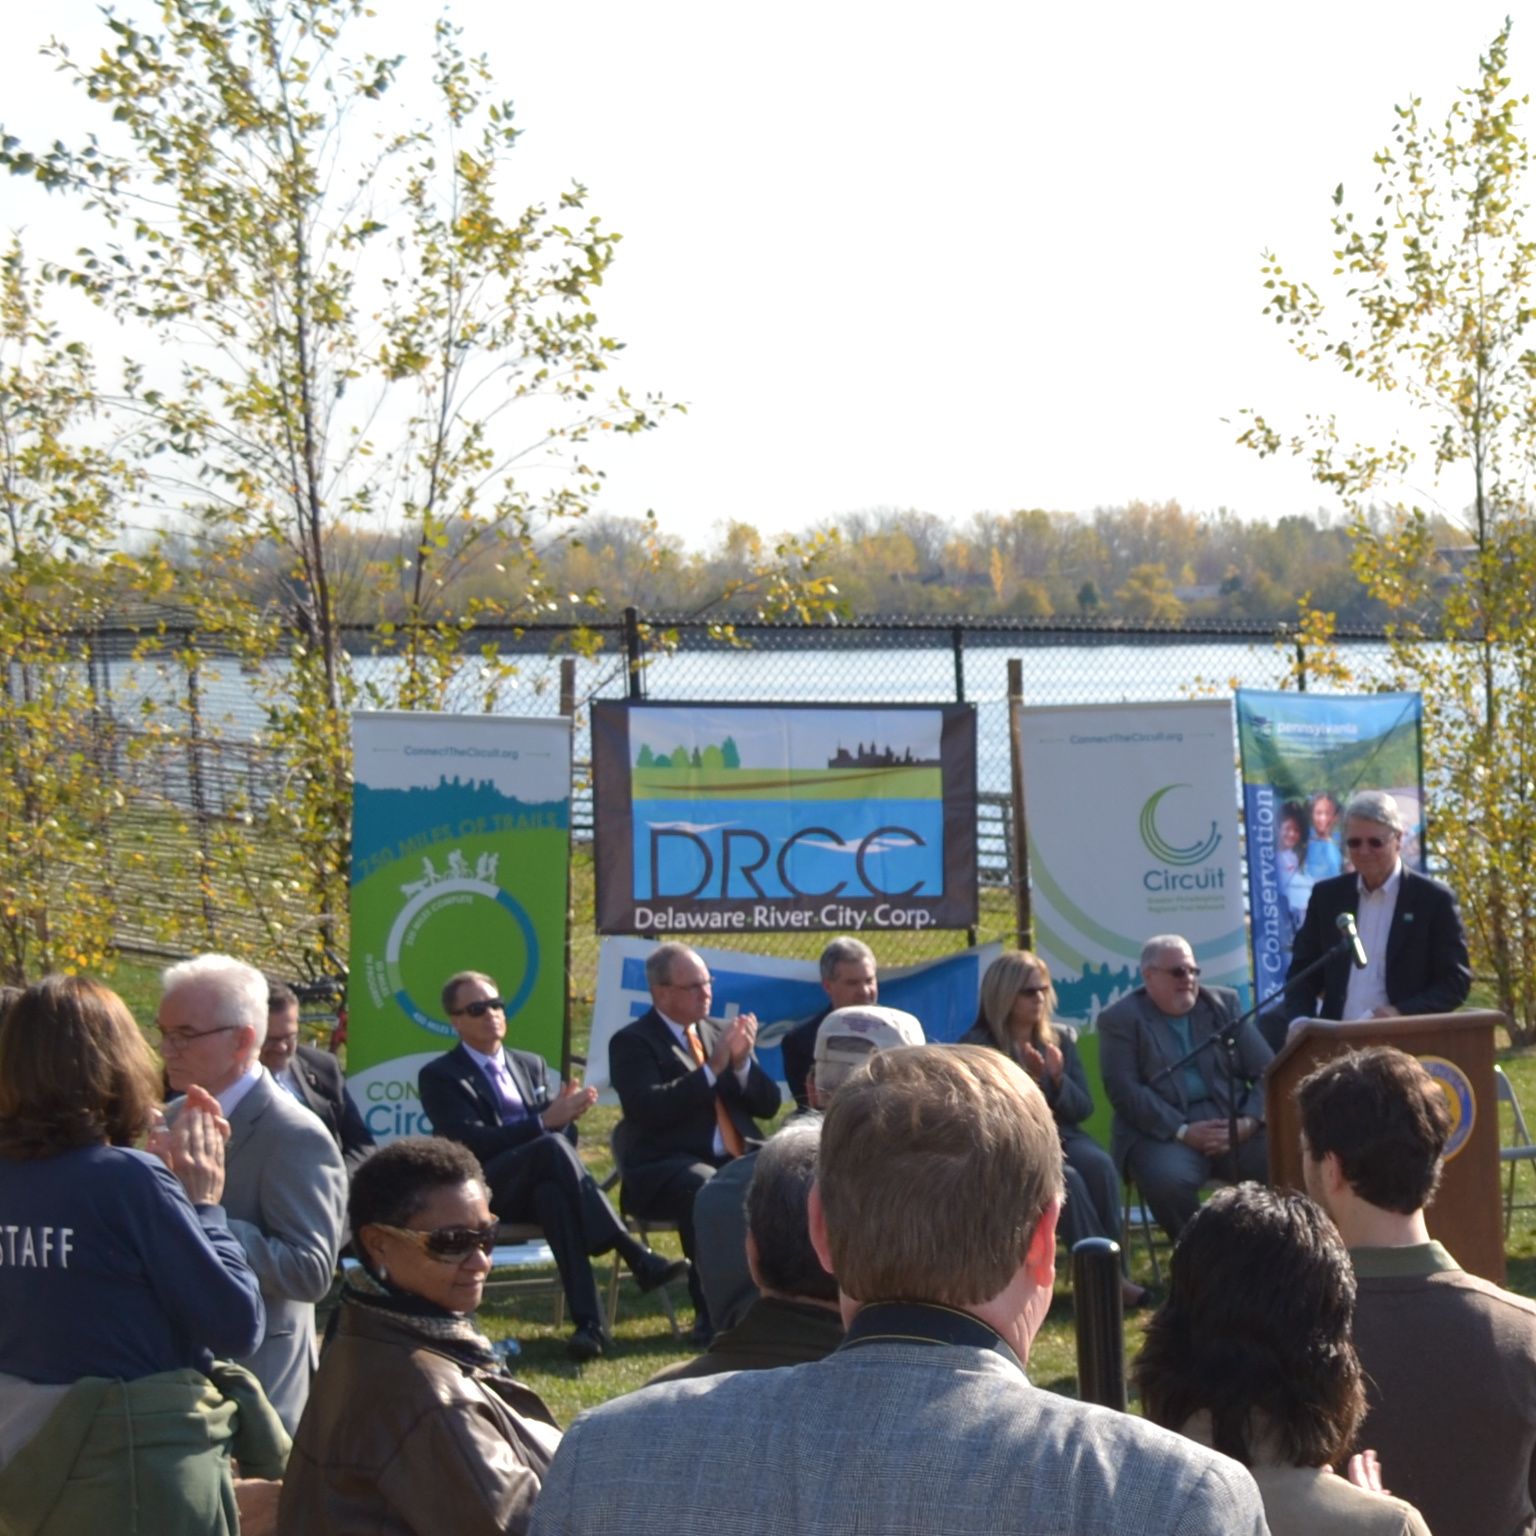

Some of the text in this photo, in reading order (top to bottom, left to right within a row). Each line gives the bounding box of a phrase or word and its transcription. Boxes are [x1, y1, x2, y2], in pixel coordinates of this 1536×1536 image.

[1070, 732, 1183, 744] ConnectTheCircuit.org
[1277, 721, 1358, 736] pennsylvania
[404, 745, 519, 760] ConnectTheCircuit.org
[398, 824, 455, 857] MILES
[458, 816, 487, 837] OF
[492, 812, 557, 831] TRAILS
[650, 826, 927, 900] DRCC
[1143, 867, 1225, 891] Circuit
[1252, 788, 1282, 974] Conservation
[634, 904, 936, 930] Delaware River City Corp.
[0, 1225, 74, 1269] TAFF
